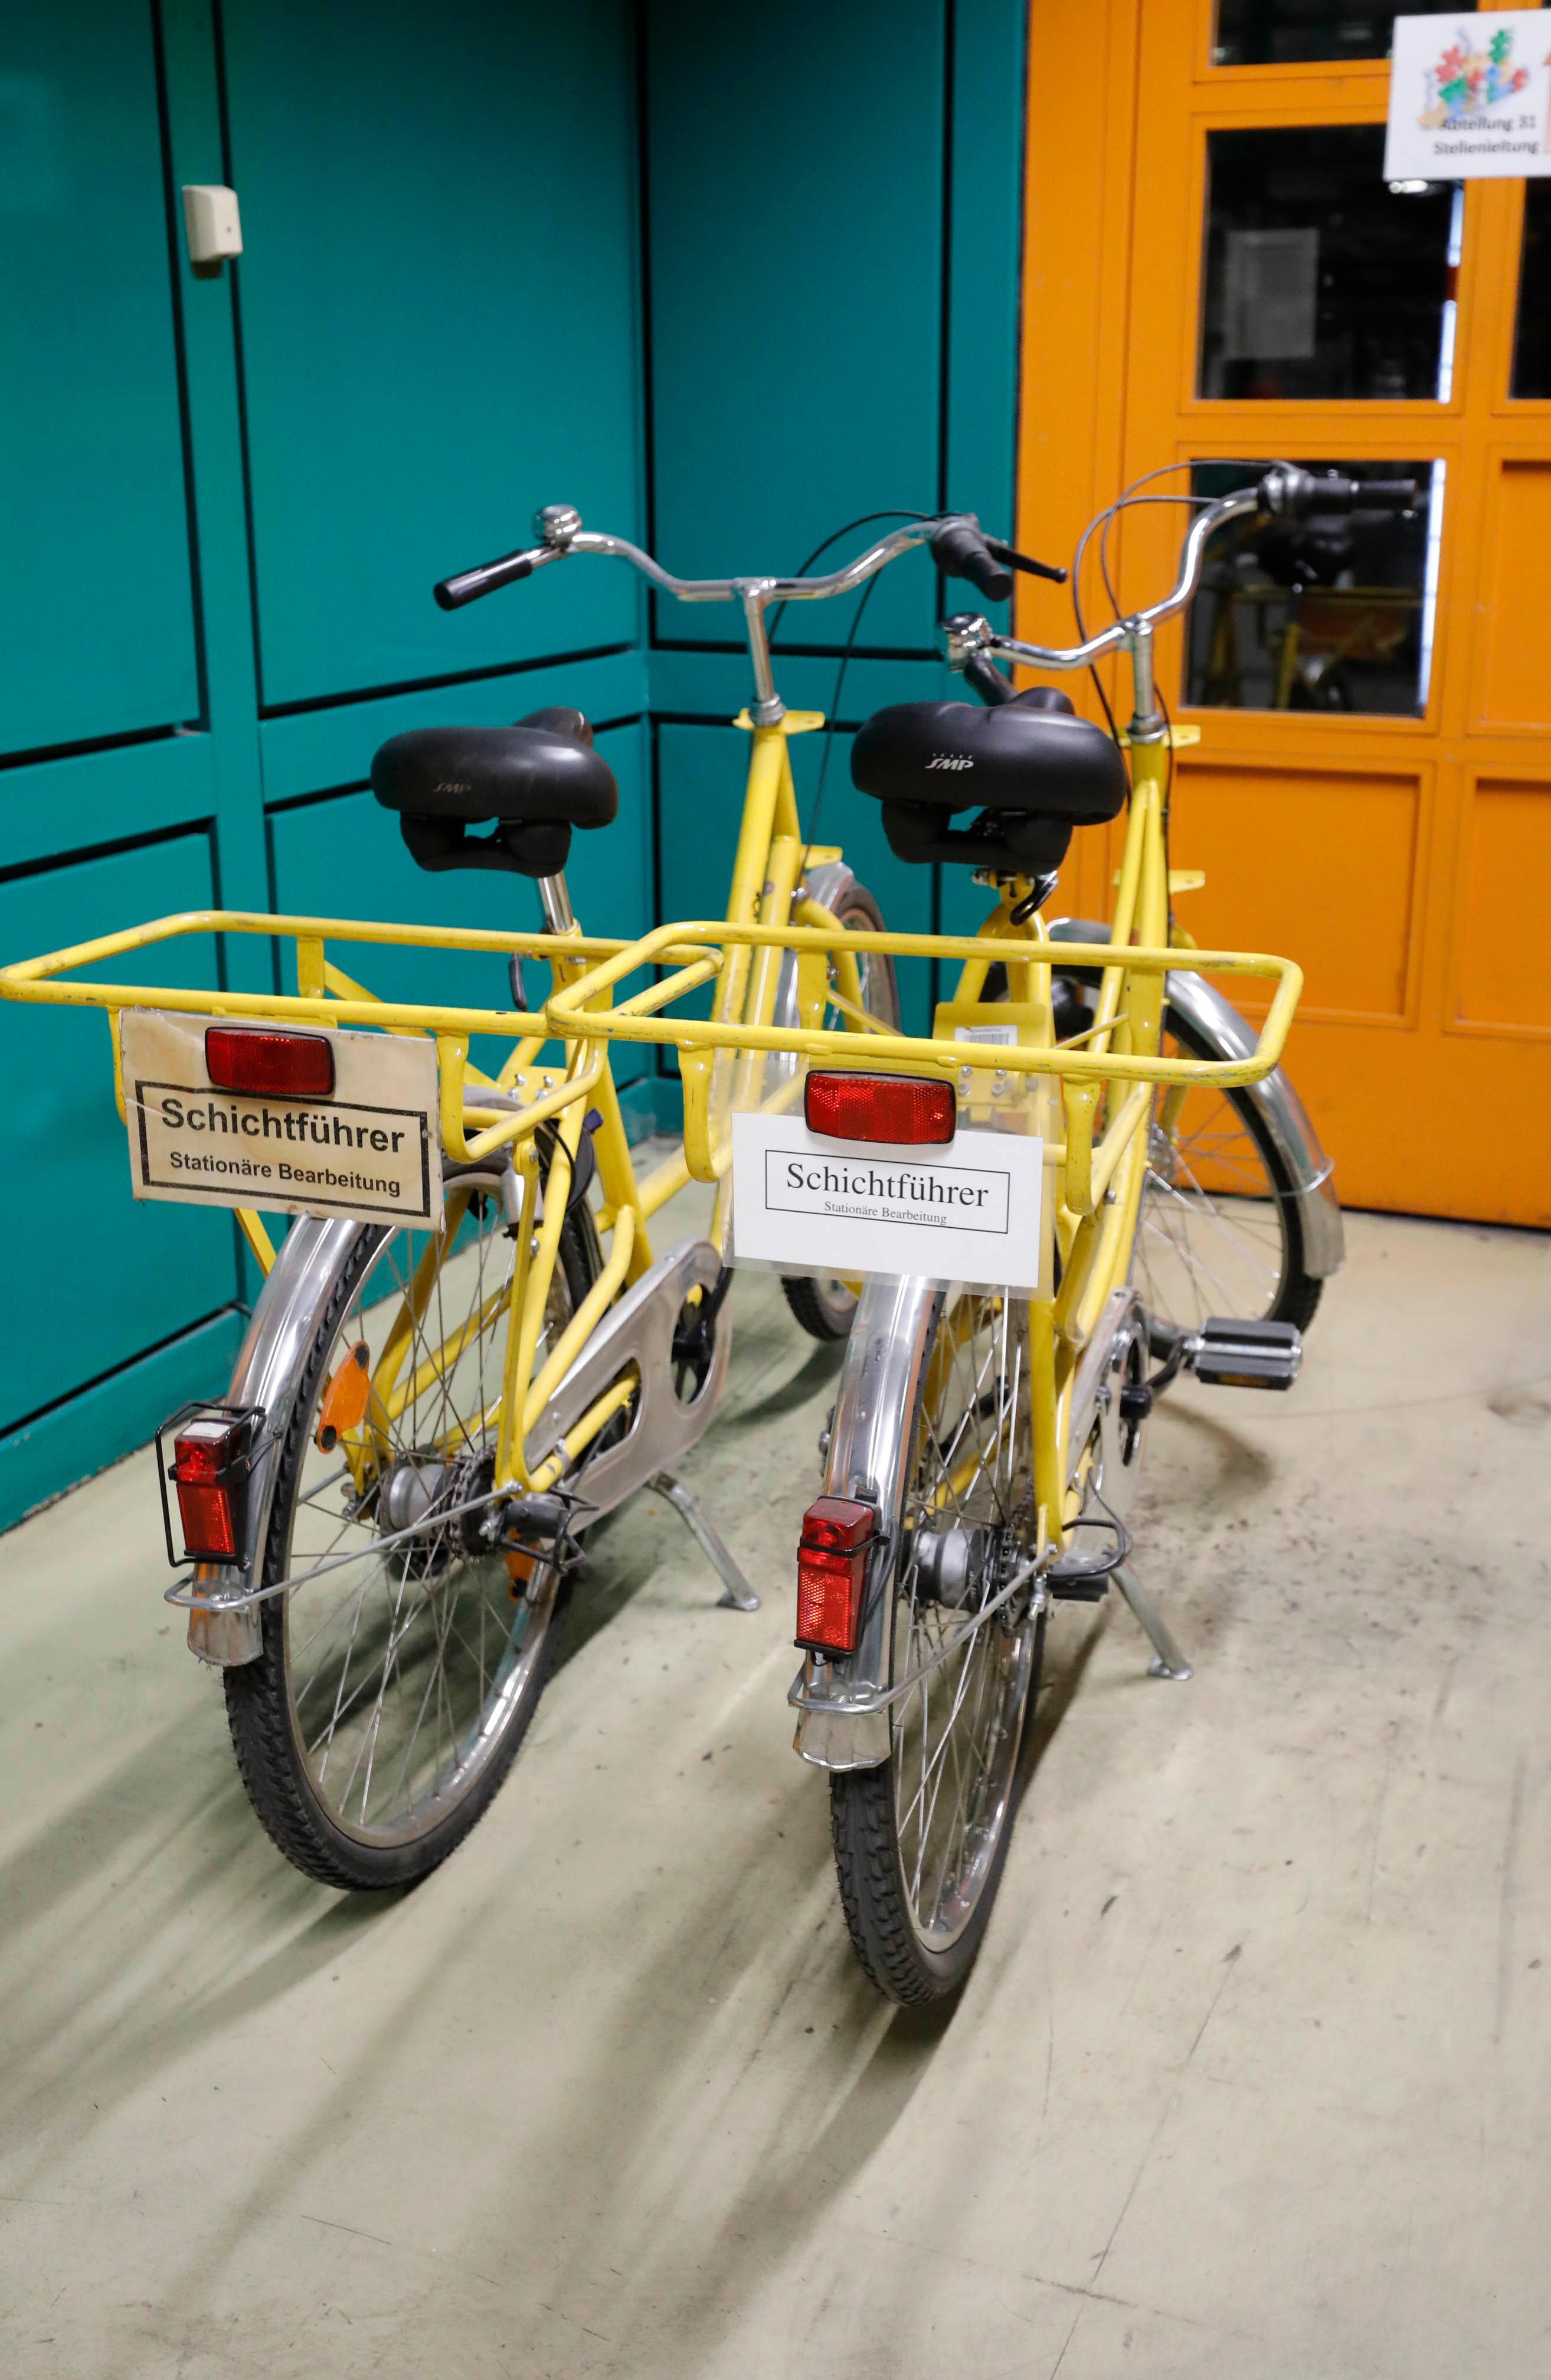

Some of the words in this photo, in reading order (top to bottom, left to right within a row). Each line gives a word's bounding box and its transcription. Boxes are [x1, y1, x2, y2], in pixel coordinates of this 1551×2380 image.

[1434, 139, 1539, 155] Stellenleitung
[925, 758, 974, 771] SMP
[161, 1097, 405, 1154] Schichtführer
[169, 1151, 272, 1178] Stationäre
[278, 1163, 401, 1198] Bearbeitung
[786, 1162, 989, 1208] Schichtführer
[824, 1201, 878, 1217] Stationäre
[881, 1207, 947, 1225] Bearbeitung
